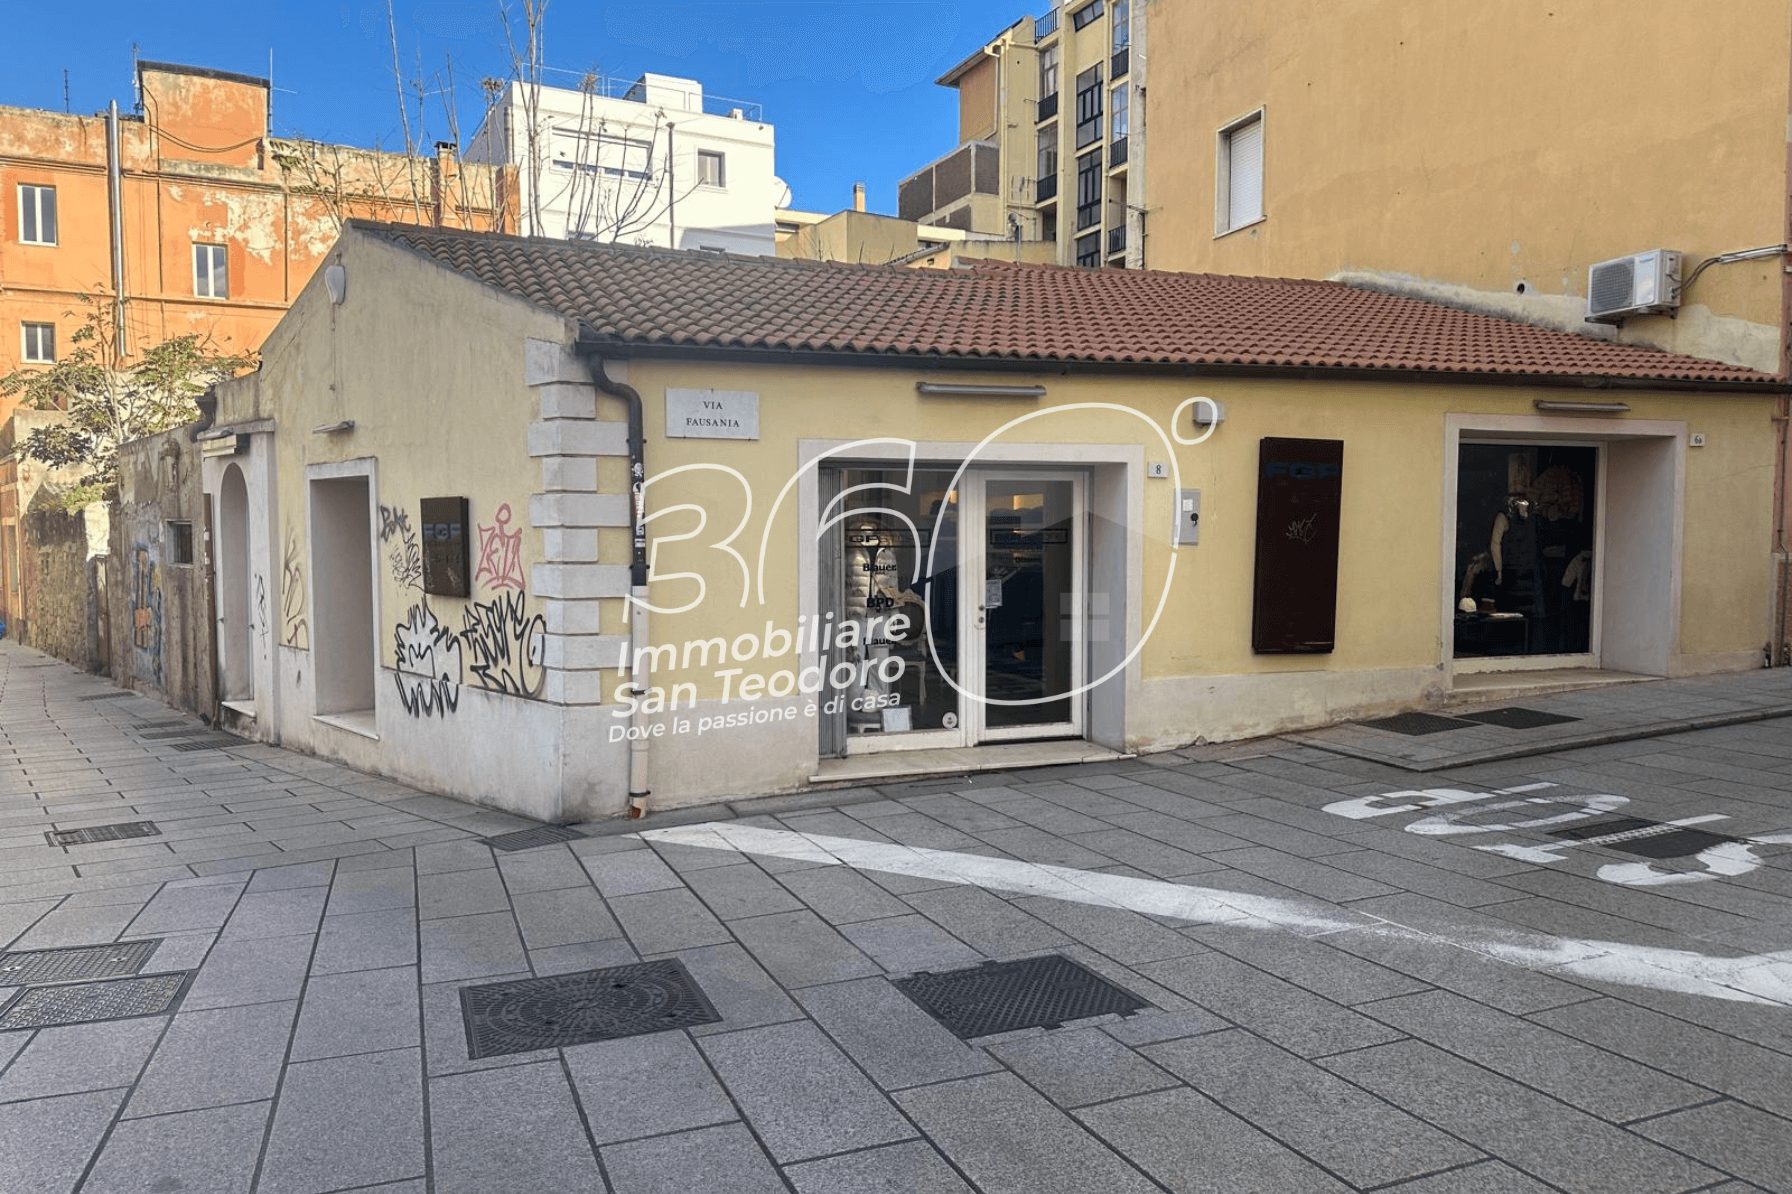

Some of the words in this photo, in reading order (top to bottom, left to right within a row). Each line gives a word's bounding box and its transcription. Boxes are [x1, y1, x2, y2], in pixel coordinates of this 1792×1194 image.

[703, 401, 723, 410] VIA
[685, 417, 740, 428] FAUSANIA
[1156, 464, 1161, 475] 8
[867, 598, 894, 608] BPD
